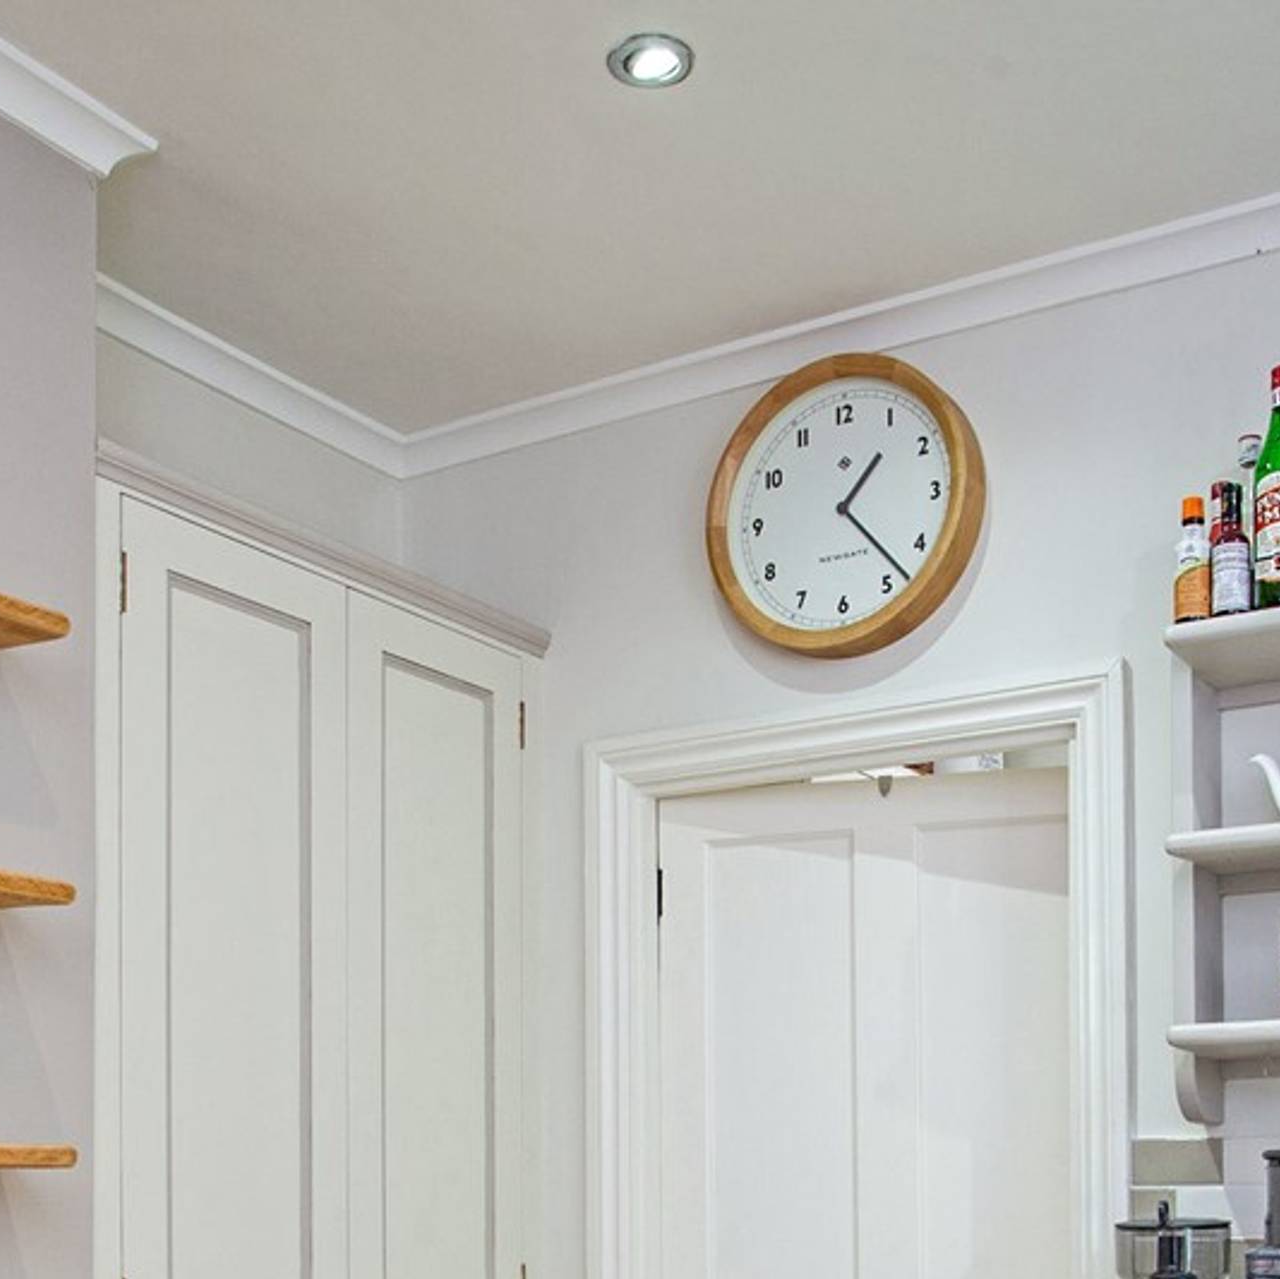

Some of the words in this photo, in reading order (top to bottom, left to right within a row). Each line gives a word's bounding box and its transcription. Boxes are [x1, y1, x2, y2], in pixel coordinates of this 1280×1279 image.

[836, 404, 854, 426] 12
[887, 407, 894, 427] 1
[797, 428, 809, 448] 11
[917, 436, 930, 456] 2
[765, 469, 783, 490] 10
[930, 480, 941, 500] 3
[752, 518, 763, 536] 9
[914, 533, 926, 552] 4
[819, 549, 869, 563] NEWGATE
[764, 562, 776, 581] 8
[881, 575, 893, 594] 5
[796, 590, 807, 609] 7
[837, 595, 850, 614] 6
